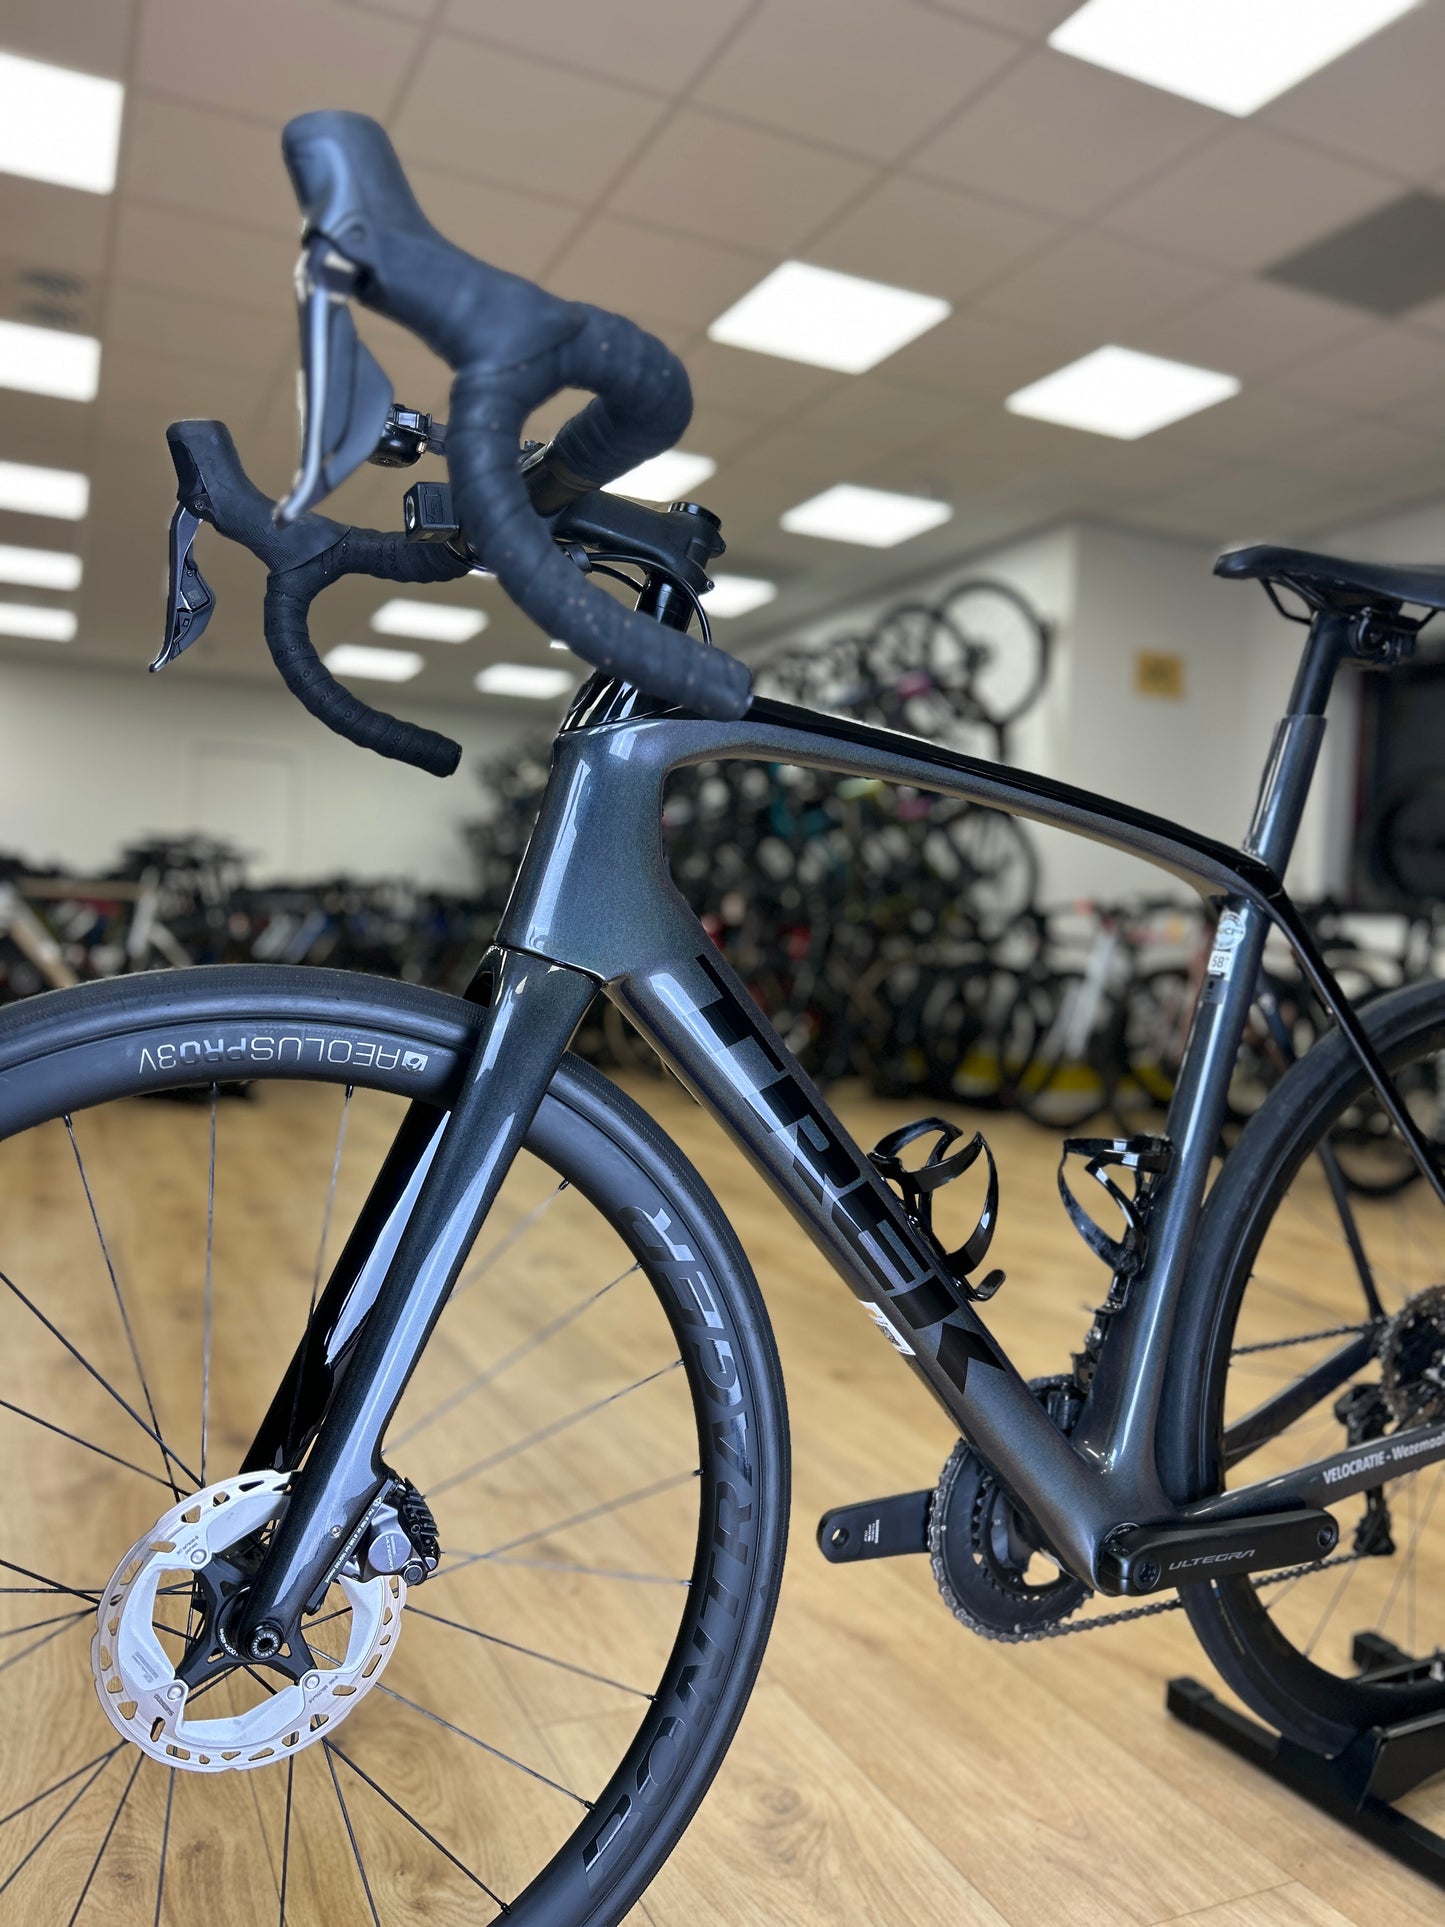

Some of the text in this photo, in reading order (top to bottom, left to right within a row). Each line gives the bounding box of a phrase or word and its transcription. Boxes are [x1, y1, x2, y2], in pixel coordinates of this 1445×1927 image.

[684, 954, 1006, 1395] TREK
[582, 1206, 753, 1898] BONTRAGER
[1168, 1549, 1256, 1571] ULTEGRA
[1322, 1450, 1386, 1485] VELOCRATIE
